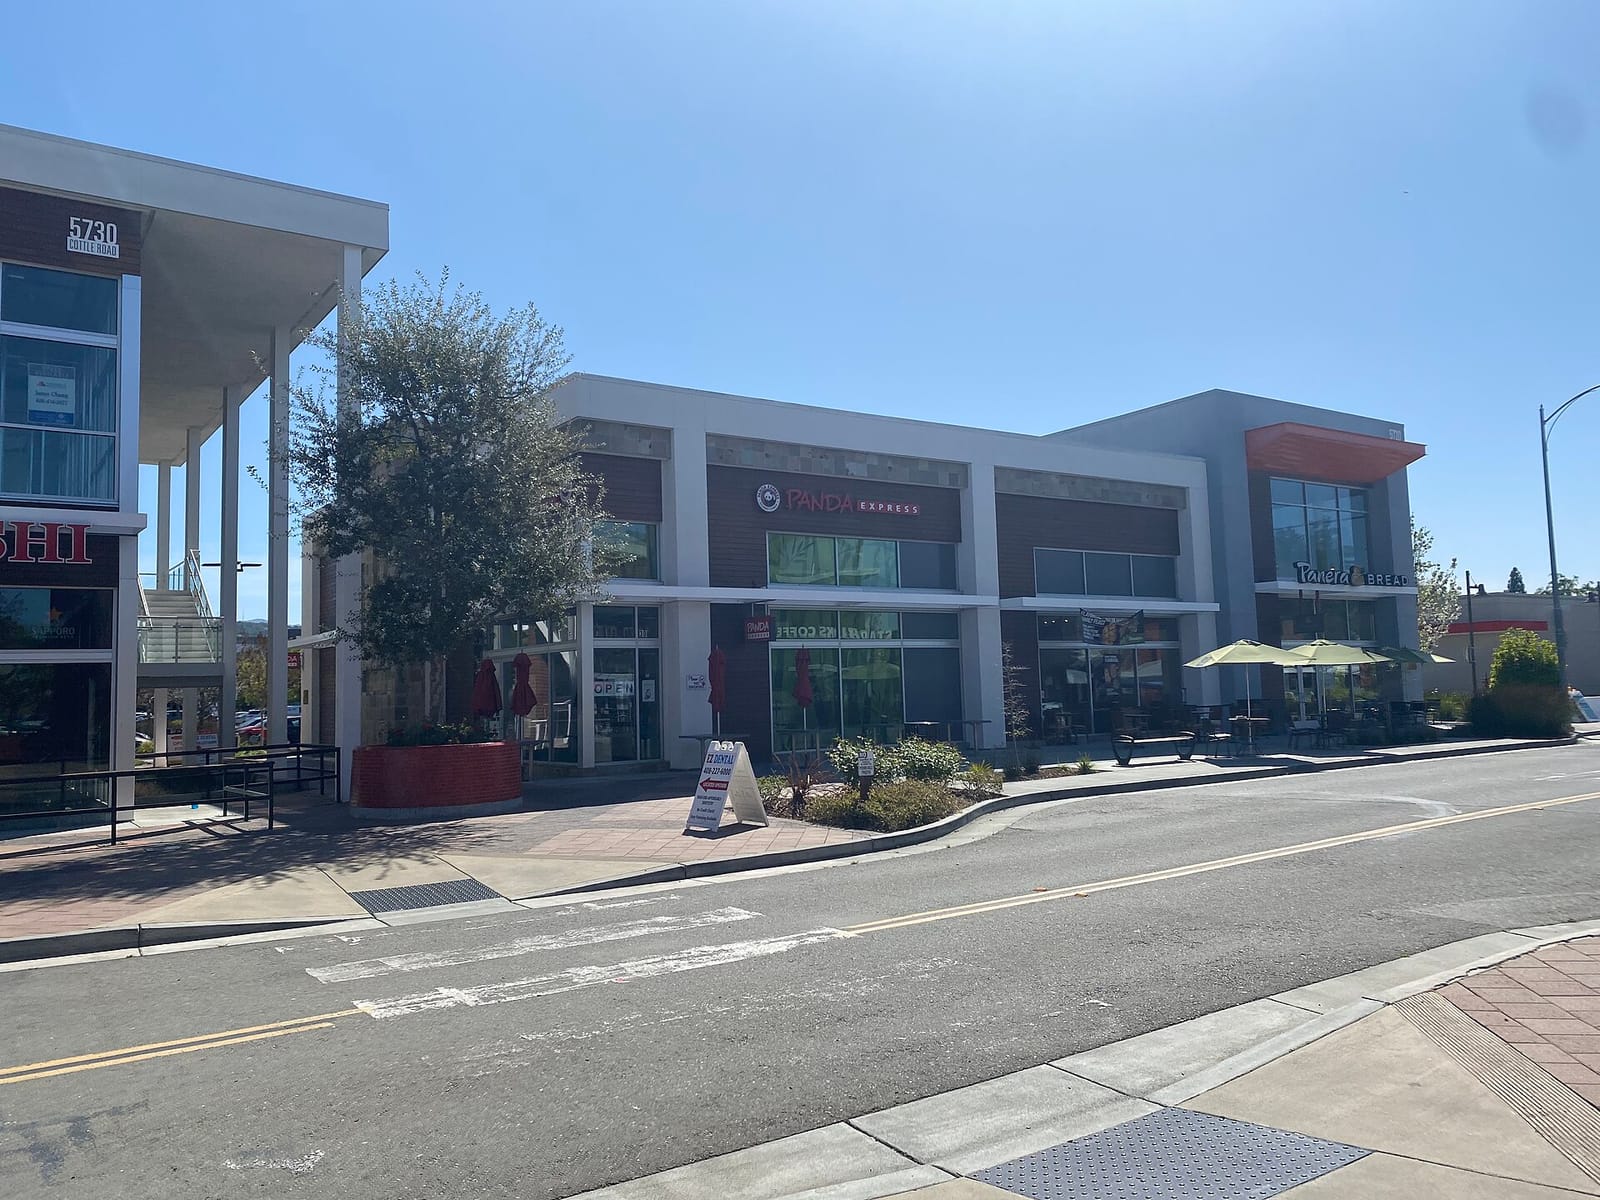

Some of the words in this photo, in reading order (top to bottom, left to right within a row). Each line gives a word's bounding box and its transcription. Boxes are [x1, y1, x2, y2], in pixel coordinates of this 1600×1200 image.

[69, 216, 117, 244] 5730
[70, 239, 94, 253] COTTLE
[96, 243, 117, 256] ROAD
[786, 488, 853, 514] PANDA
[860, 501, 919, 514] EXPRESS
[0, 519, 92, 564] HI
[1295, 560, 1350, 584] Panera
[1367, 573, 1410, 586] BREAD
[31, 626, 76, 635] SAPPORO
[746, 621, 770, 633] PANDA
[594, 683, 633, 695] OPEN
[706, 753, 714, 764] EZ
[713, 754, 734, 765] DENTAL
